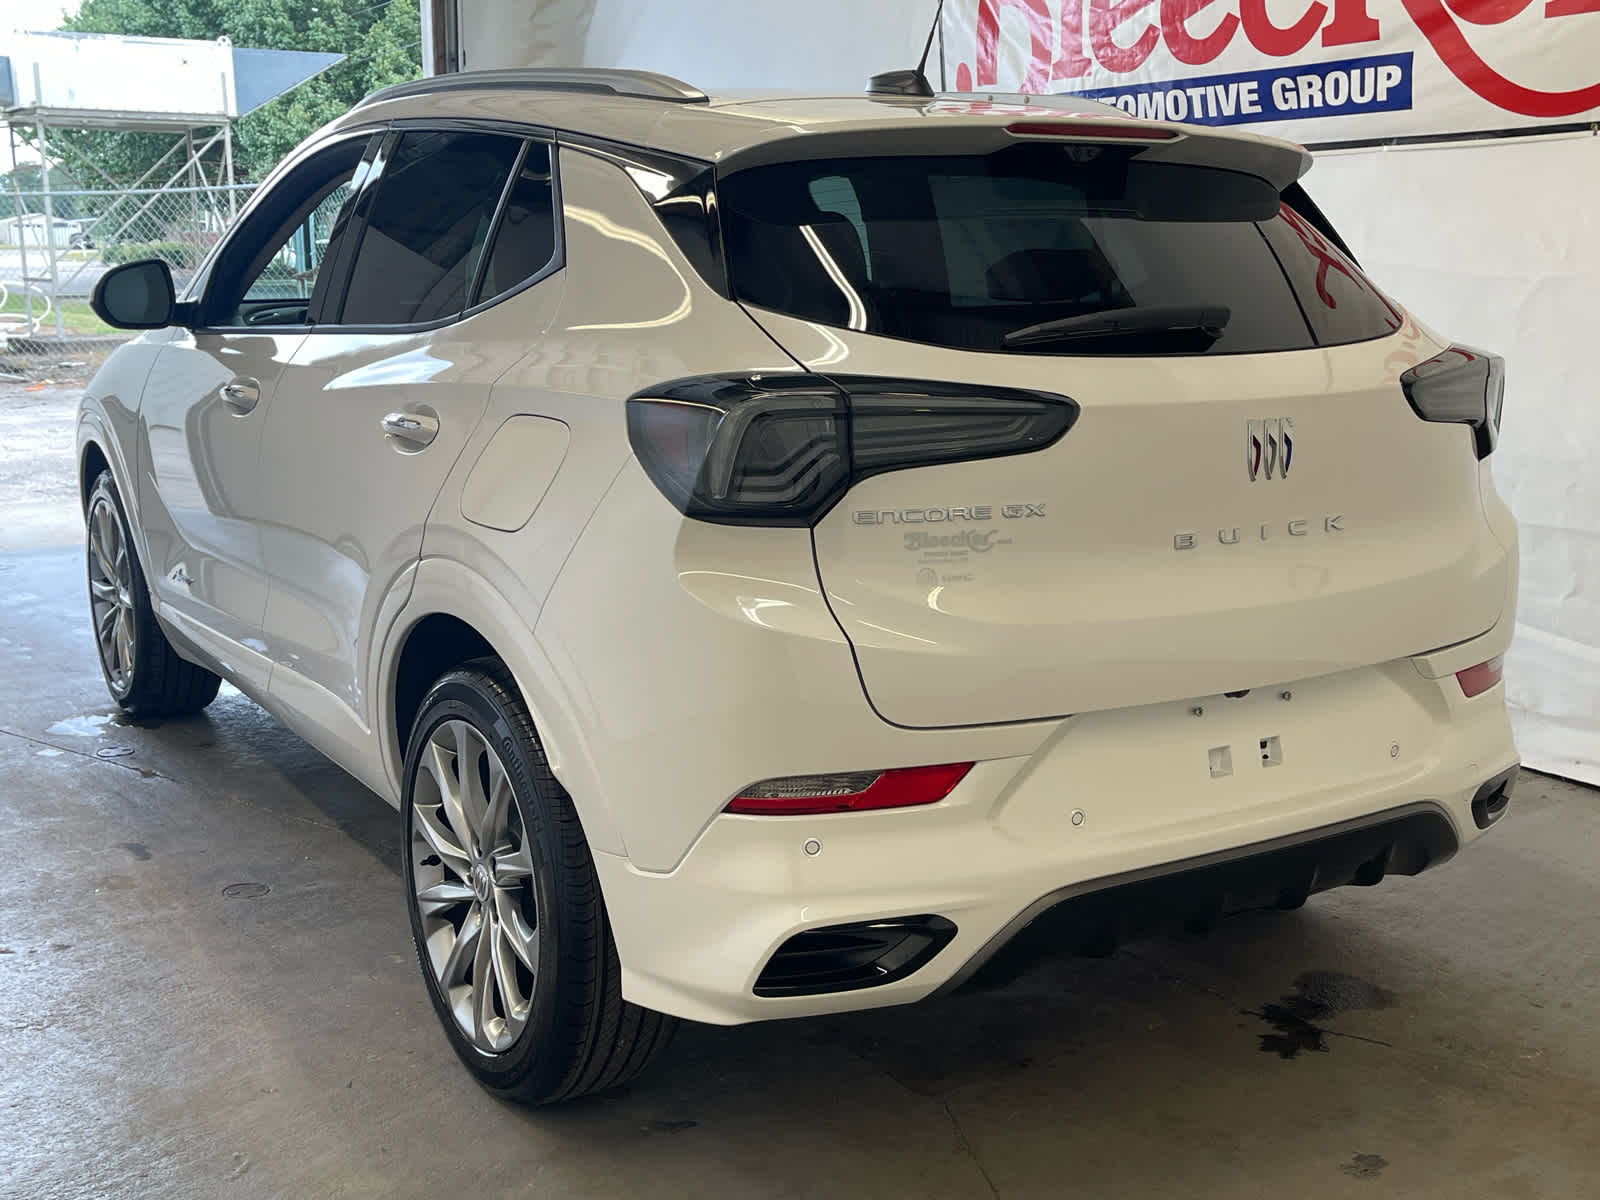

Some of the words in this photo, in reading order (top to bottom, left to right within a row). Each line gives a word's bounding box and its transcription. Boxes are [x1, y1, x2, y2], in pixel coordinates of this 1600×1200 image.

[1271, 64, 1402, 111] GROUP
[852, 505, 993, 525] ENCORE
[1001, 503, 1047, 519] GX
[1172, 514, 1346, 552] BUICK
